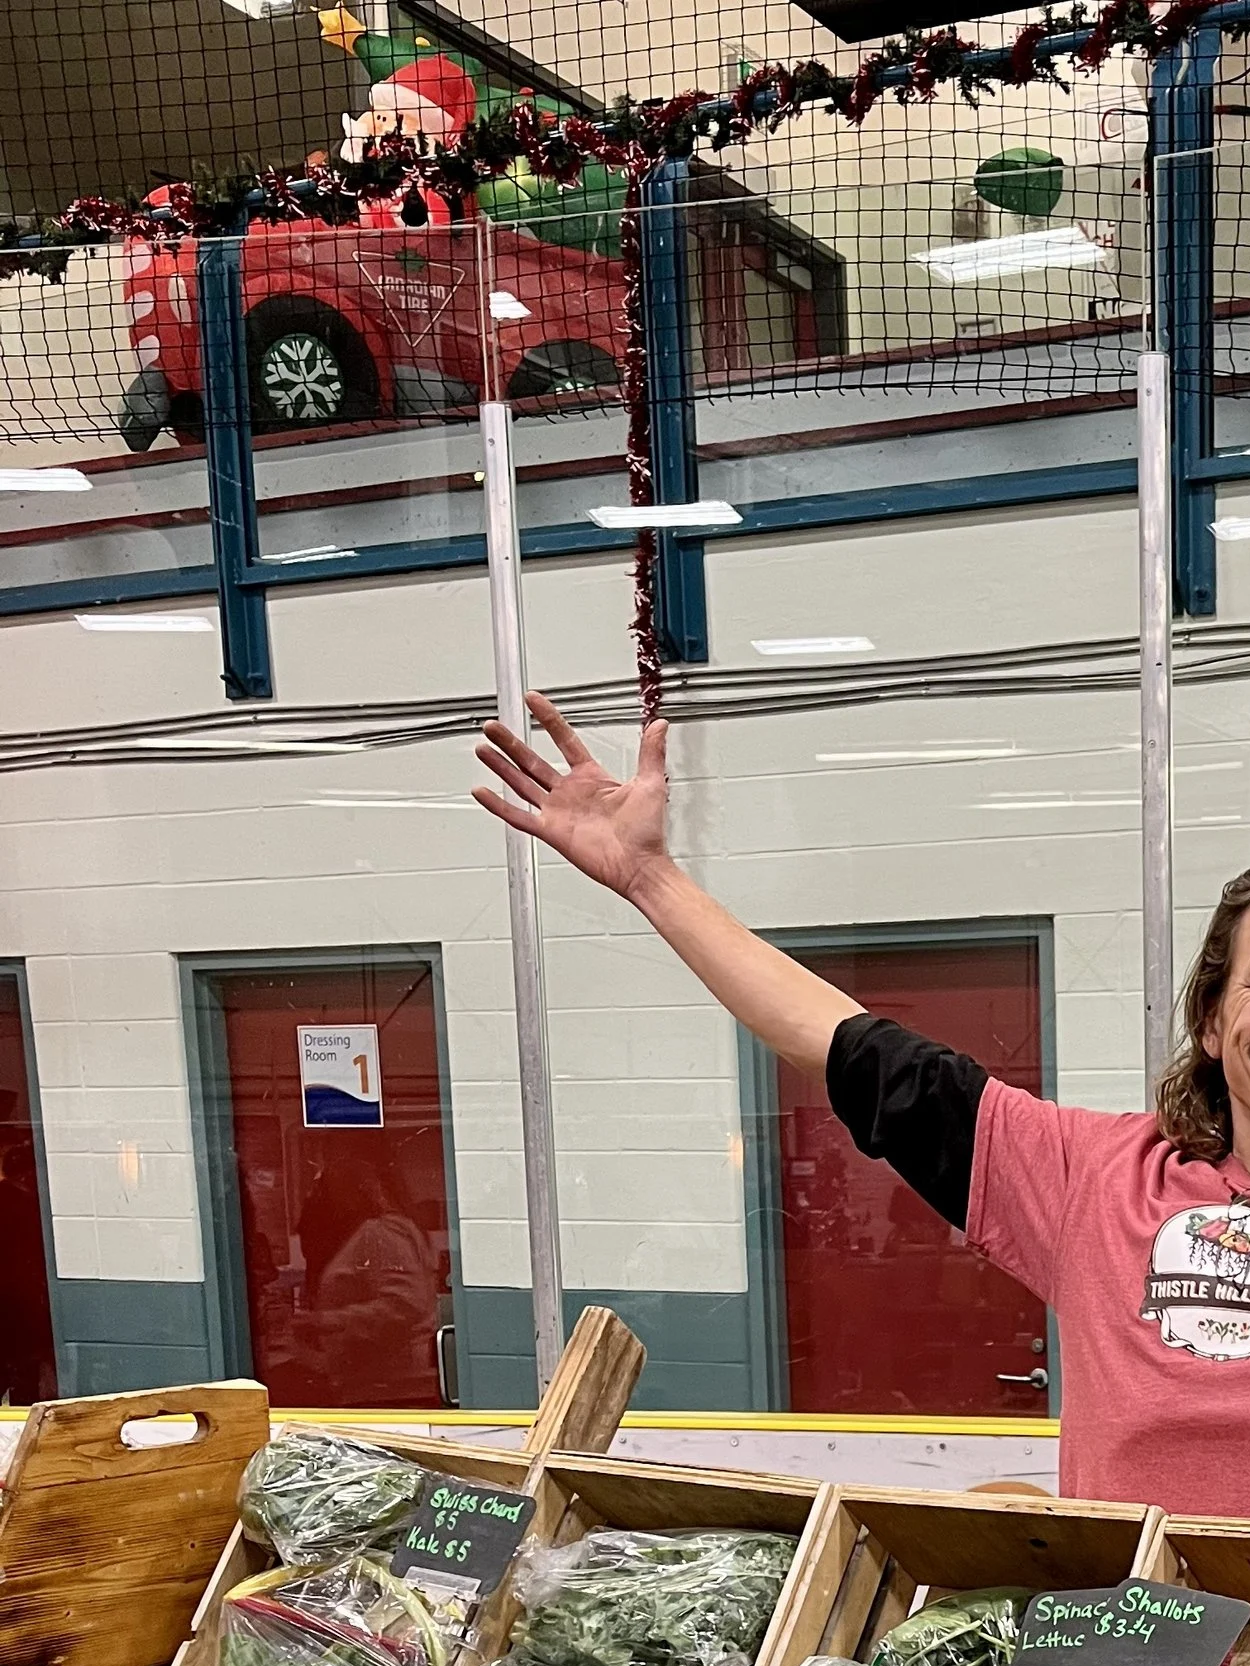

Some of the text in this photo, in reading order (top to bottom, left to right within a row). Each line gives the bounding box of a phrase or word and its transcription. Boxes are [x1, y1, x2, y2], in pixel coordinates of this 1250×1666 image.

[377, 275, 445, 299] CANADIAN
[400, 294, 429, 313] TIRE
[304, 1034, 351, 1049] Dressing
[305, 1050, 337, 1062] Room
[353, 1054, 369, 1094] 1
[1150, 1280, 1210, 1299] THISTLE
[1215, 1283, 1250, 1304] HILL
[430, 1487, 525, 1523] Swiss Chard
[434, 1510, 459, 1531] $5
[406, 1526, 472, 1562] Kale $5
[1035, 1596, 1111, 1625] Spinac
[1118, 1586, 1205, 1625] Shallots
[1021, 1631, 1085, 1650] Lettuc
